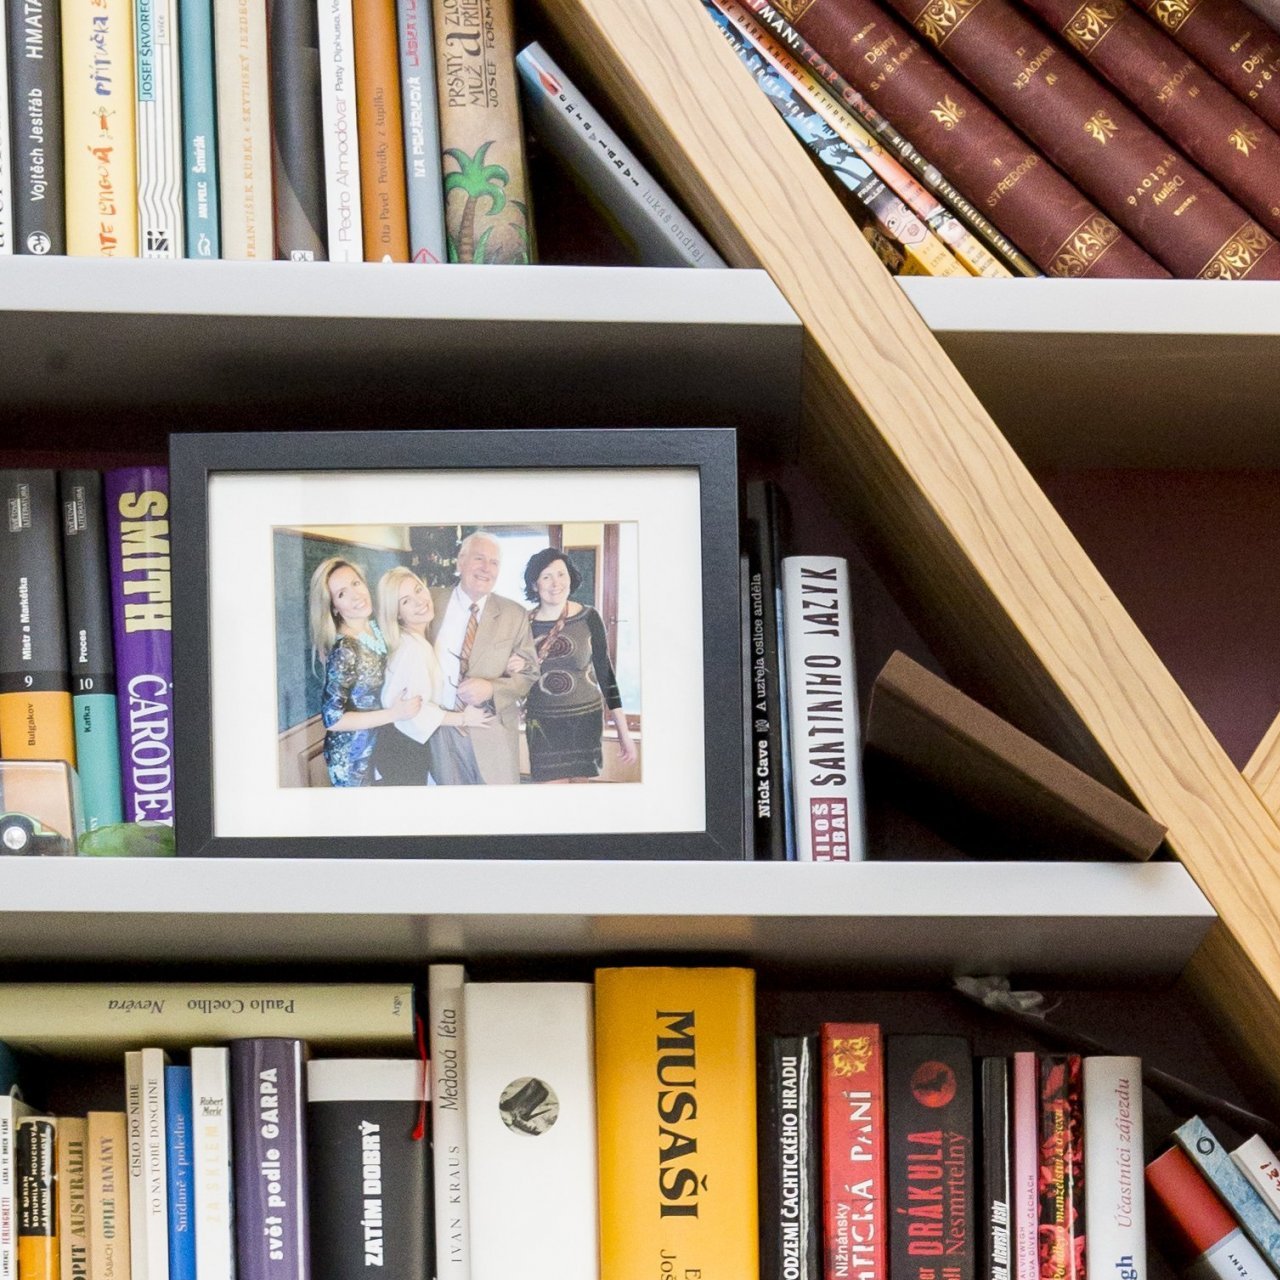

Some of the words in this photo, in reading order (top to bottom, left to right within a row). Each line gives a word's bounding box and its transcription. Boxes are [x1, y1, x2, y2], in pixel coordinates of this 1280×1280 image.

[29, 88, 43, 143] Jestřáb
[30, 146, 48, 201] Vojtěch
[118, 490, 172, 633] SMITH
[800, 567, 840, 637] JAZYK
[79, 629, 87, 663] Proces
[24, 675, 33, 688] 9
[79, 677, 93, 690] 10
[84, 705, 92, 733] Kafka
[805, 655, 847, 787] SANTINIHO
[187, 1000, 246, 1014] Coelho
[251, 1000, 295, 1014] Paulo
[259, 1067, 278, 1140] GARPA
[782, 1056, 797, 1109] HRADU
[655, 1008, 710, 1219] MUSAŠI
[846, 1090, 873, 1162] PANÍ
[263, 1147, 284, 1208] podle
[359, 1120, 382, 1198] DOBRÝ
[781, 1112, 799, 1219] ČACHTICKÉHO
[264, 1216, 284, 1261] svět
[363, 1203, 384, 1267] ZATÍM
